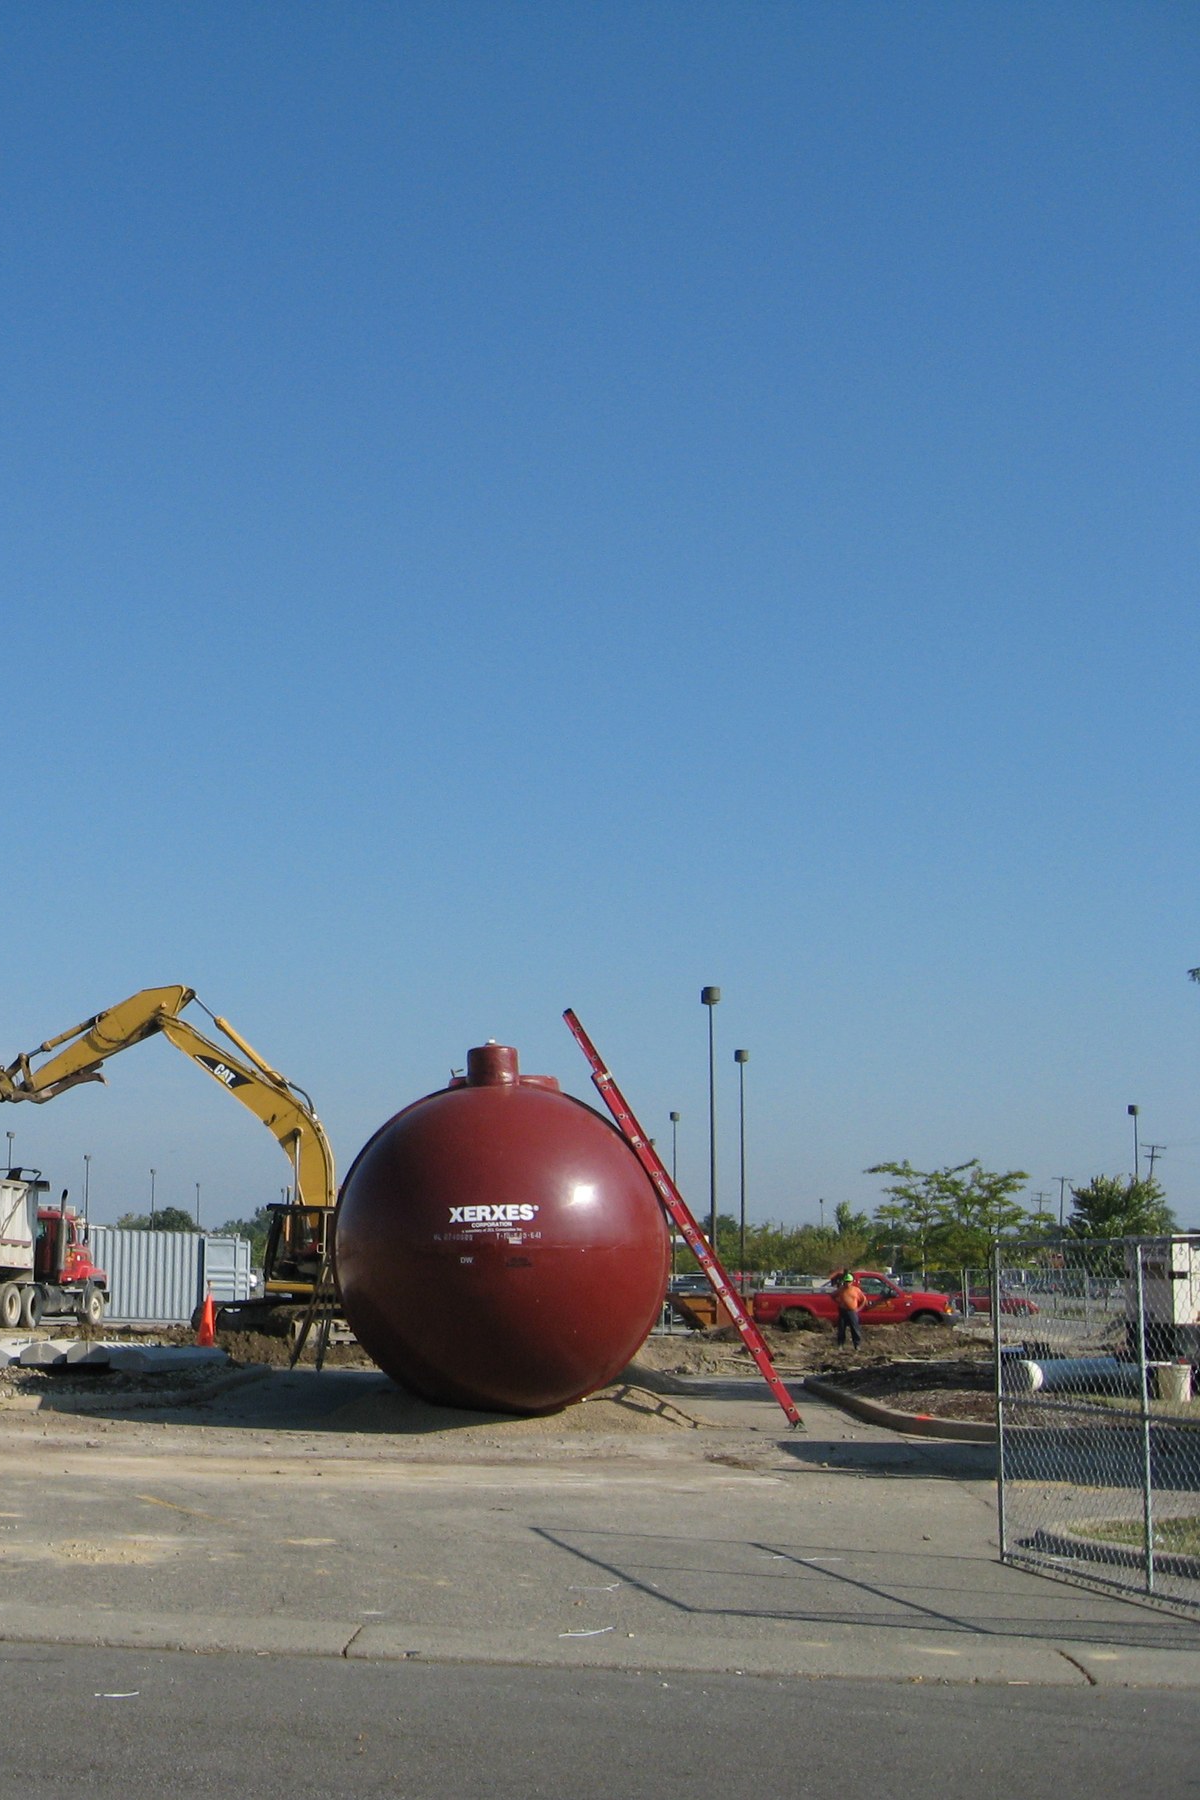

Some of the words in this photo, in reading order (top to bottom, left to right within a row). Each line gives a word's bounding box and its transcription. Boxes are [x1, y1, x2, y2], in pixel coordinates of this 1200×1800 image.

[213, 1063, 237, 1085] CAT
[448, 1204, 535, 1223] XERXES
[471, 1221, 513, 1229] CORPORATION
[460, 1256, 474, 1264] DW
